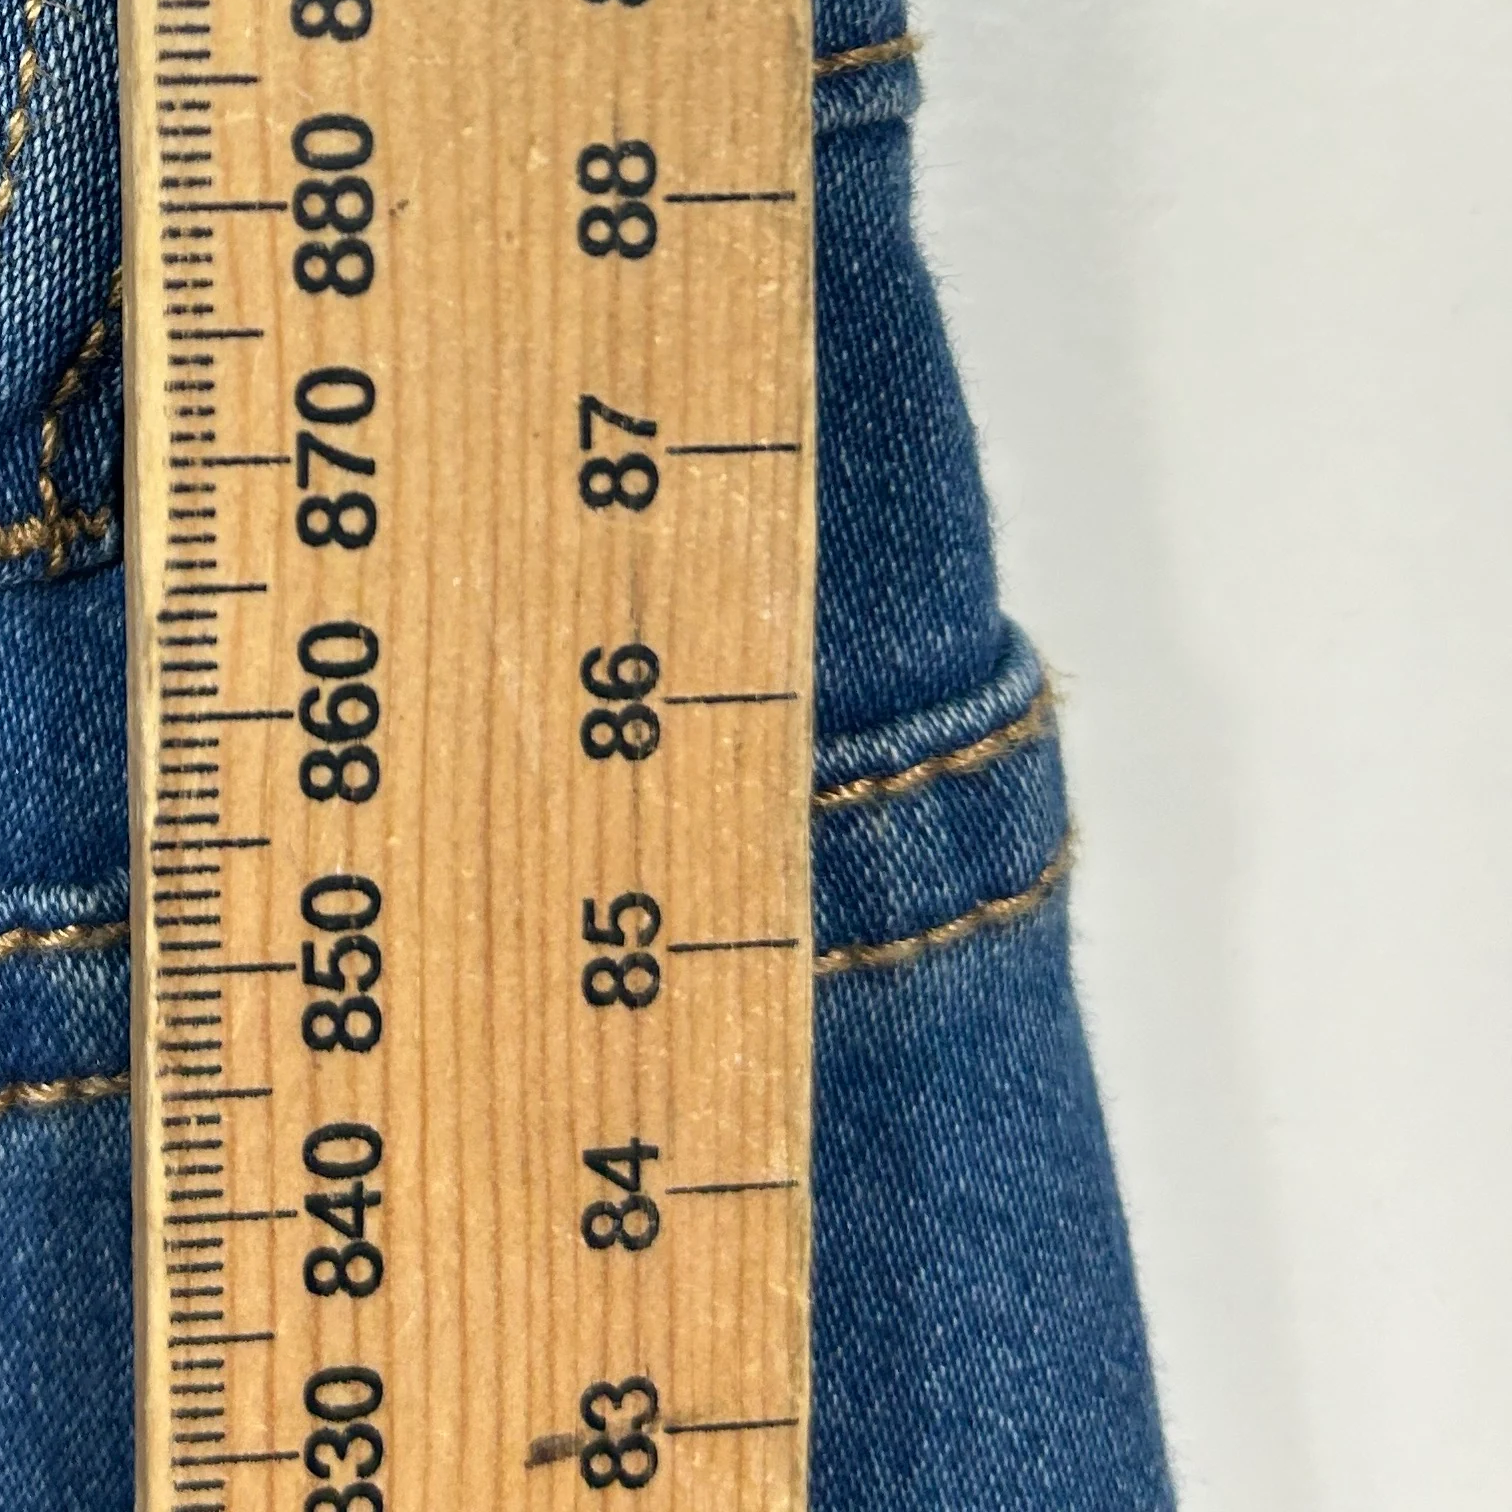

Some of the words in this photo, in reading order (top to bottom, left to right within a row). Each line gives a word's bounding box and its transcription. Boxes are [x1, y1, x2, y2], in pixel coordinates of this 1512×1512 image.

[291, 114, 375, 298] 880
[577, 140, 658, 261] 88
[294, 367, 378, 551] 870
[578, 394, 660, 513] 87
[297, 621, 381, 805] 860
[579, 643, 661, 763] 86
[300, 874, 383, 1054] 850
[581, 892, 662, 1012] 85
[302, 1122, 385, 1300] 840
[580, 1136, 661, 1253] 84
[580, 1376, 659, 1490] 83
